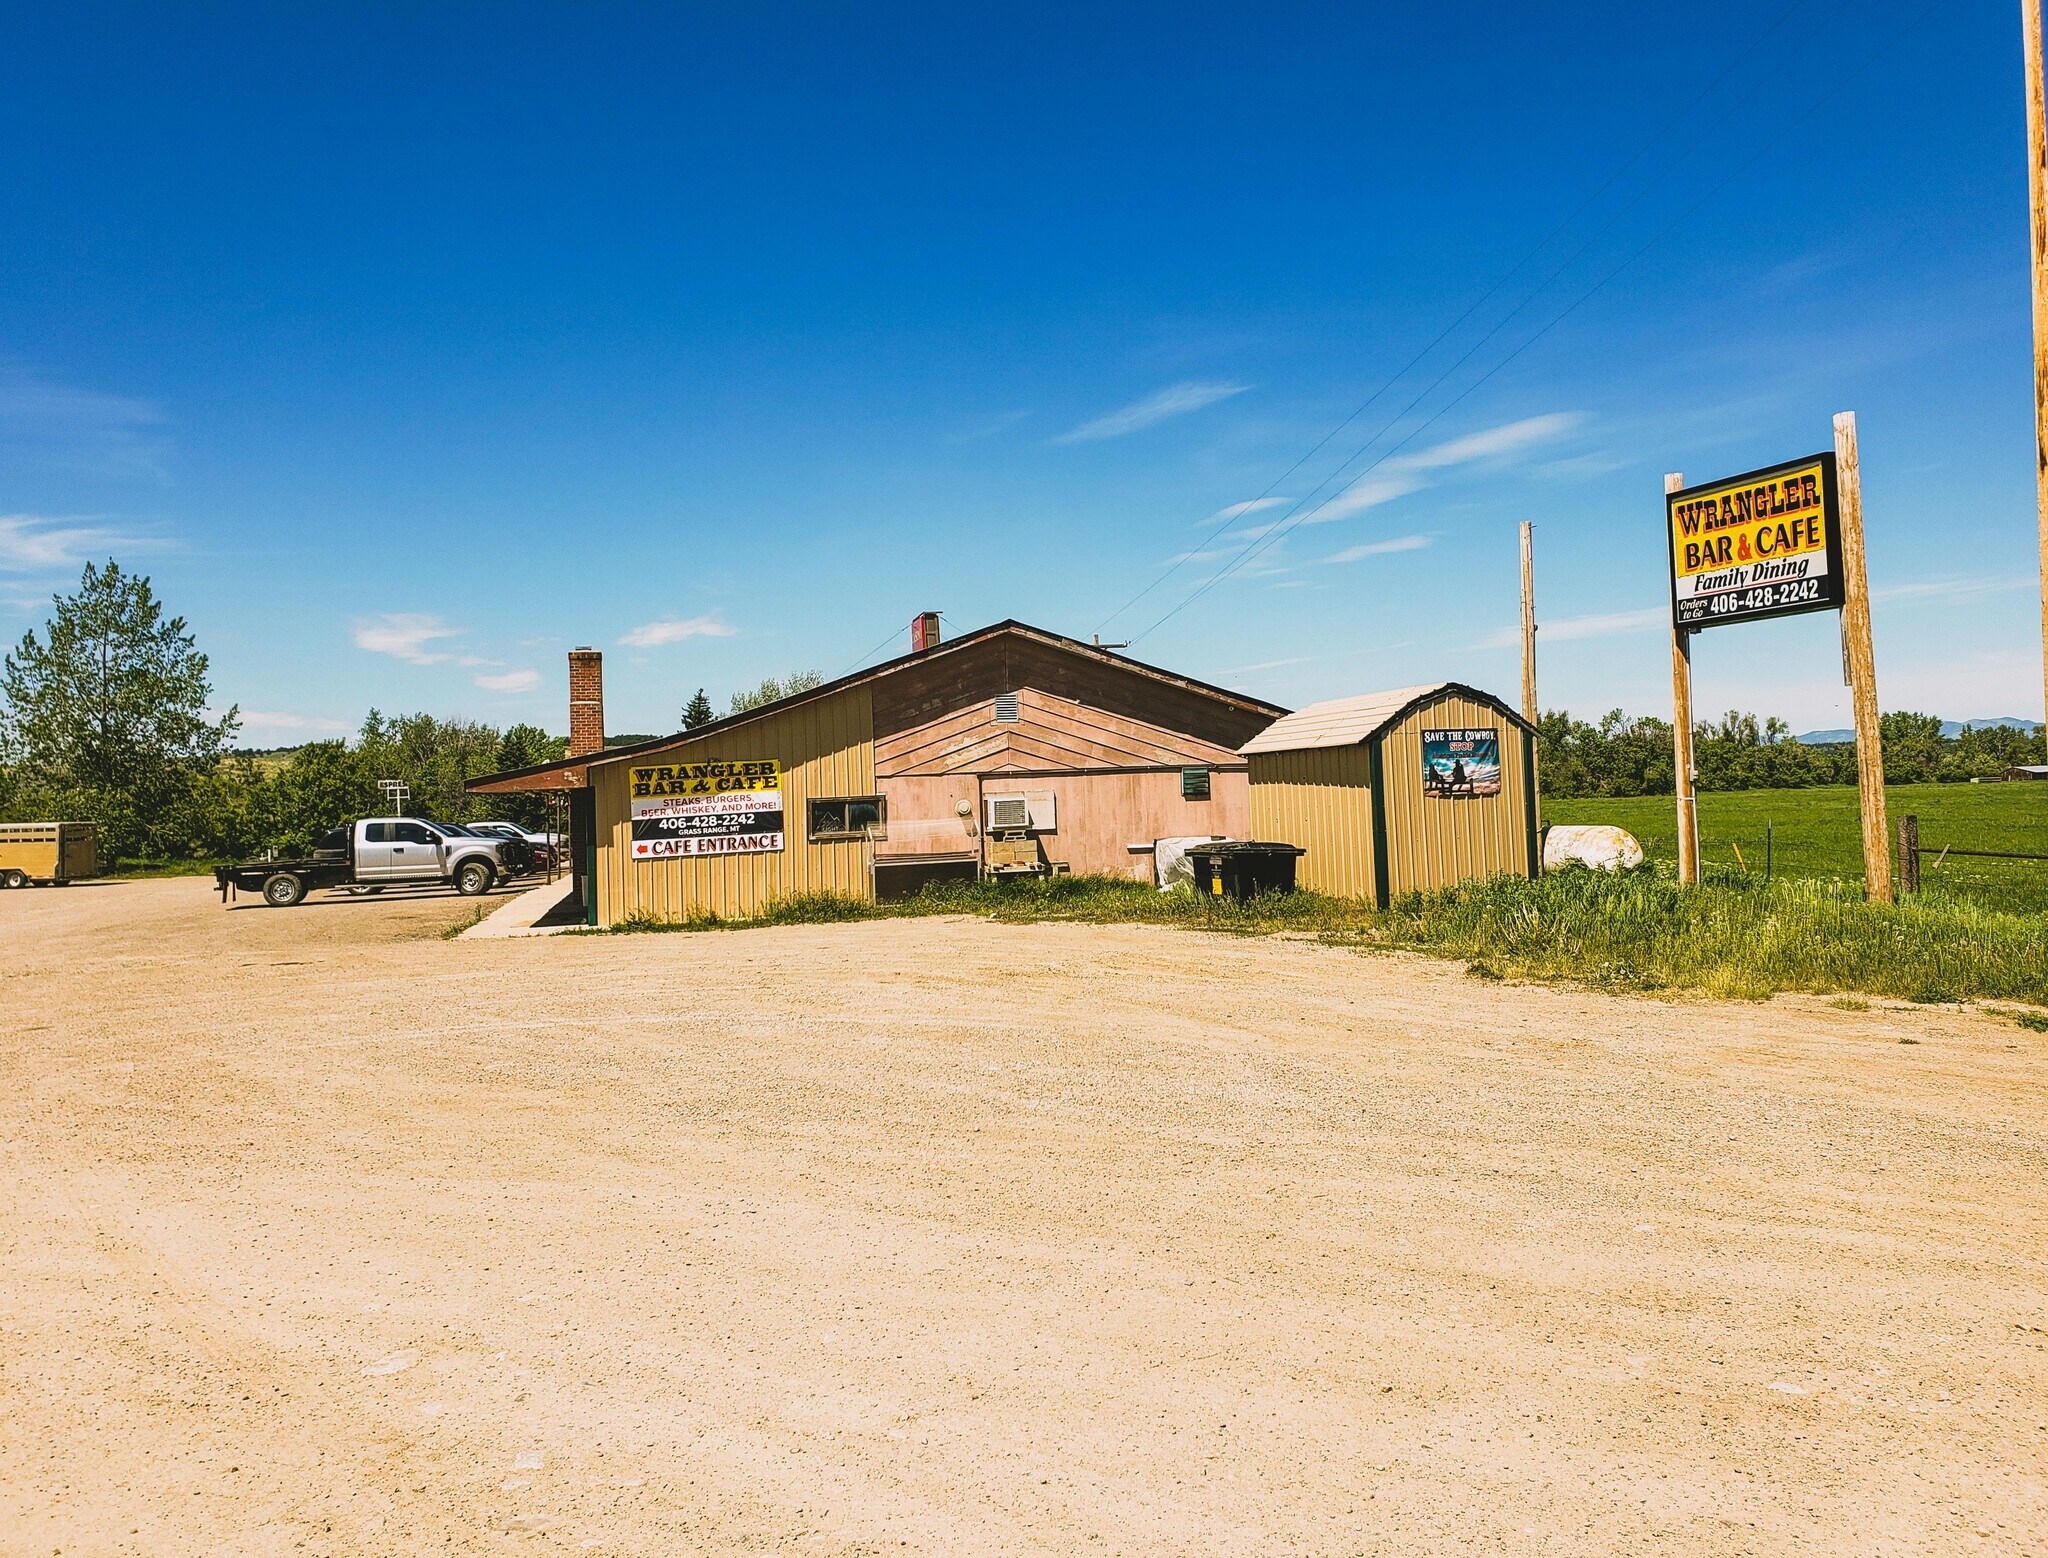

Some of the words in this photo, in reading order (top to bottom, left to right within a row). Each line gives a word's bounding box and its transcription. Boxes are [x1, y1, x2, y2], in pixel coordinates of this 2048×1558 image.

[1676, 474, 1820, 538] WRANGLER
[1685, 536, 1733, 573] BAR
[1737, 533, 1752, 561] &
[1755, 515, 1820, 559] CAFE
[1694, 568, 1748, 592] Family
[1752, 558, 1809, 582] Dining
[1680, 599, 1708, 611] Orders
[1711, 579, 1819, 614] 406-428-2242
[1683, 609, 1691, 619] to
[1692, 608, 1703, 618] Go
[1424, 731, 1445, 743] SAVE
[1447, 731, 1463, 741] THE
[1449, 741, 1474, 751] STOP
[633, 762, 776, 783] WRANGLER
[633, 781, 686, 798] BAR
[691, 779, 711, 794] &
[715, 776, 778, 792] CAFE
[721, 804, 743, 812] AND
[745, 801, 777, 811] MORE!
[658, 813, 755, 830] 406-428-2242
[651, 839, 692, 856] CAFE
[697, 834, 778, 852] ENTRANCE
